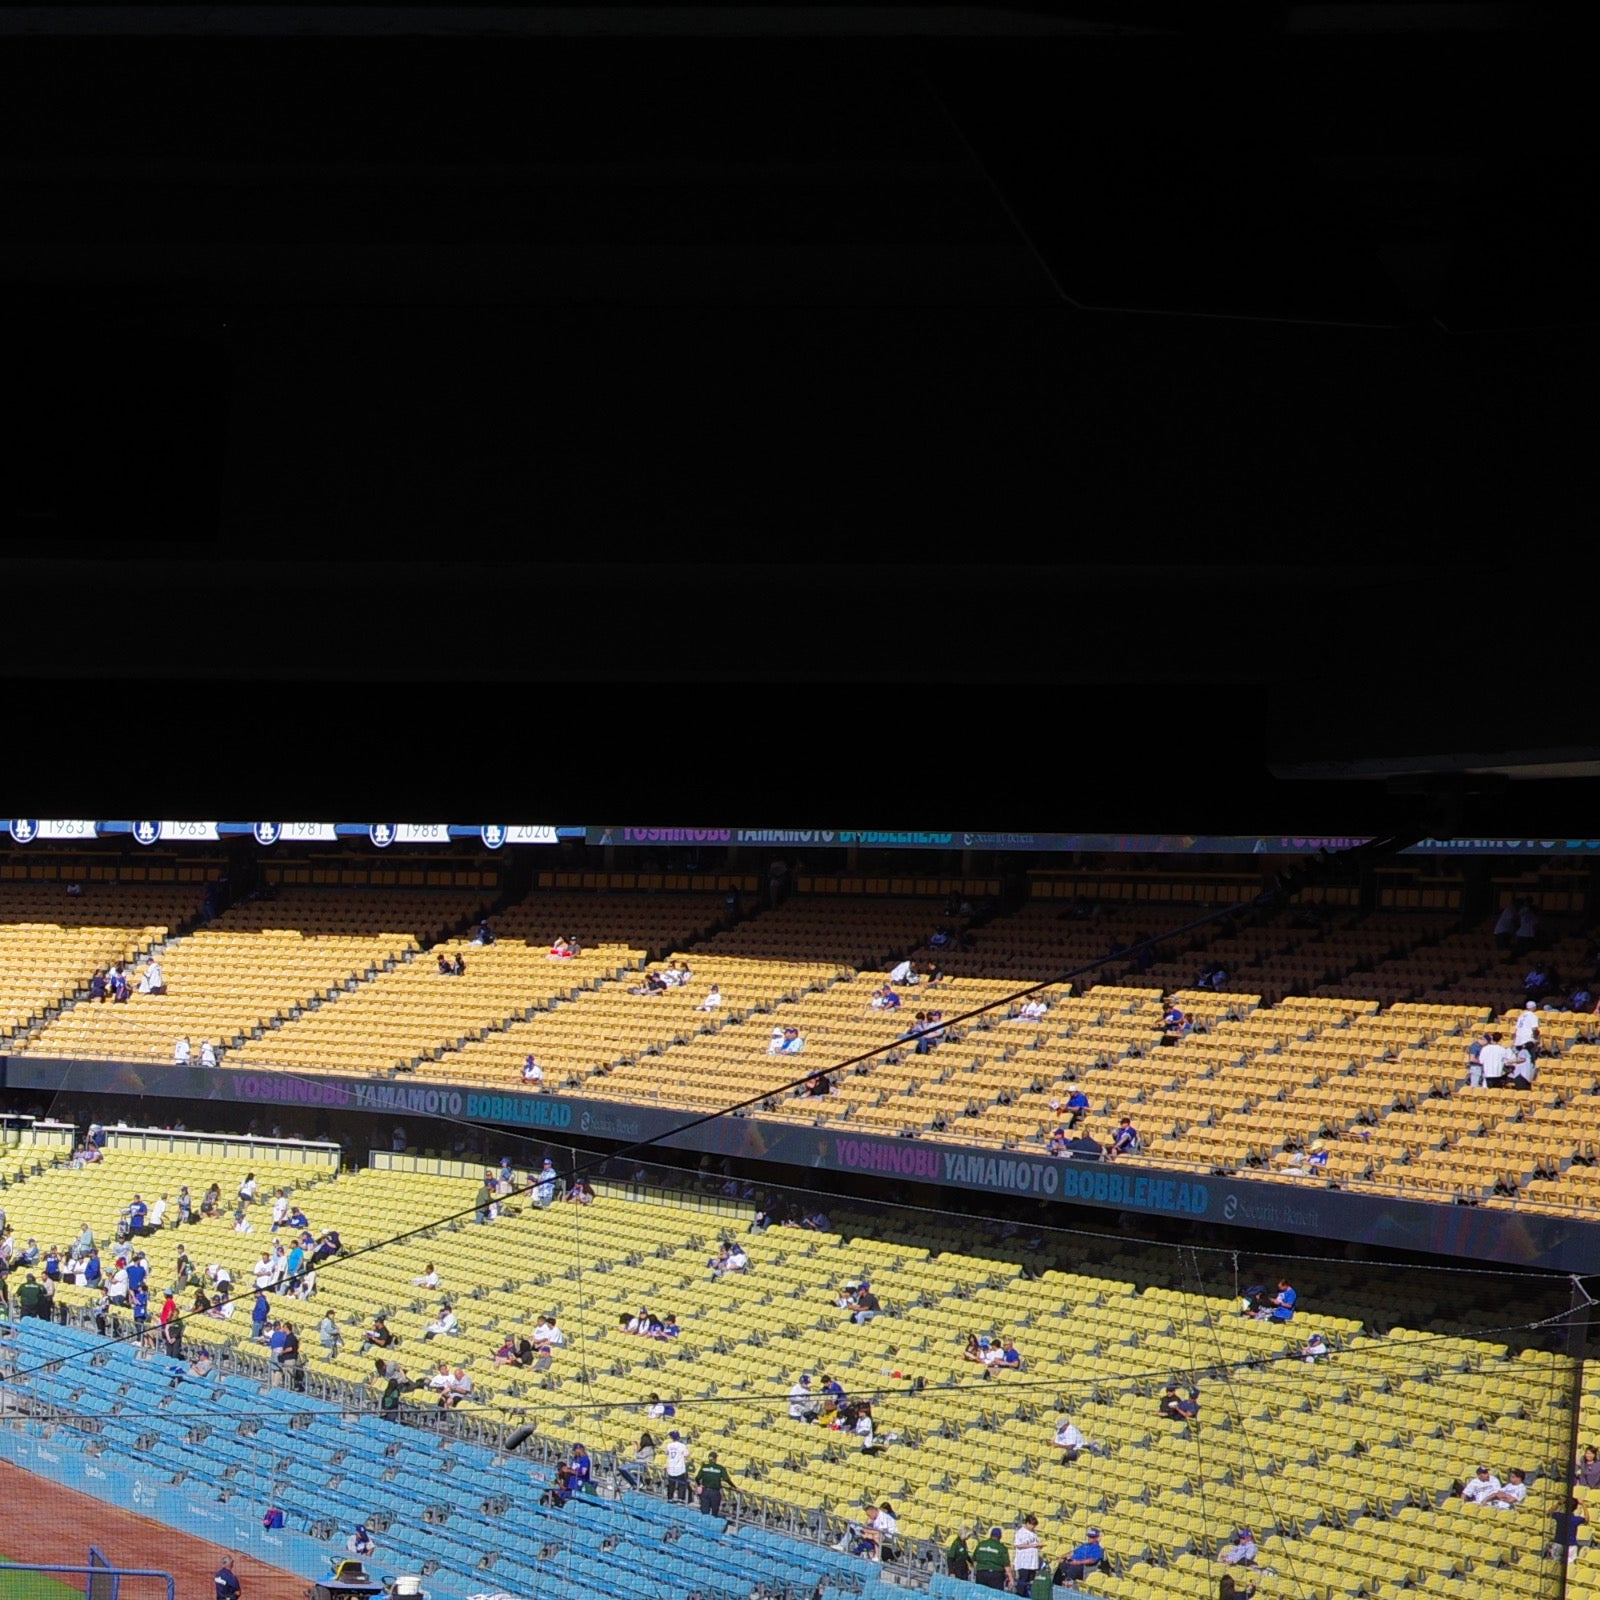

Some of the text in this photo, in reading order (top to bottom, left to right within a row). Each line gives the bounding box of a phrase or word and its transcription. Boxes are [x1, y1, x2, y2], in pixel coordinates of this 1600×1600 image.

[50, 819, 85, 834] 1963
[171, 822, 207, 835] 1965
[406, 824, 439, 837] 1988
[517, 825, 550, 838] 2020
[232, 1075, 571, 1127] YOSHINOBU YAMAMOTO BOBBLEHEAD
[835, 1139, 1209, 1214] YOSHINOBU YAMAMOTO BOBBLEHEAD
